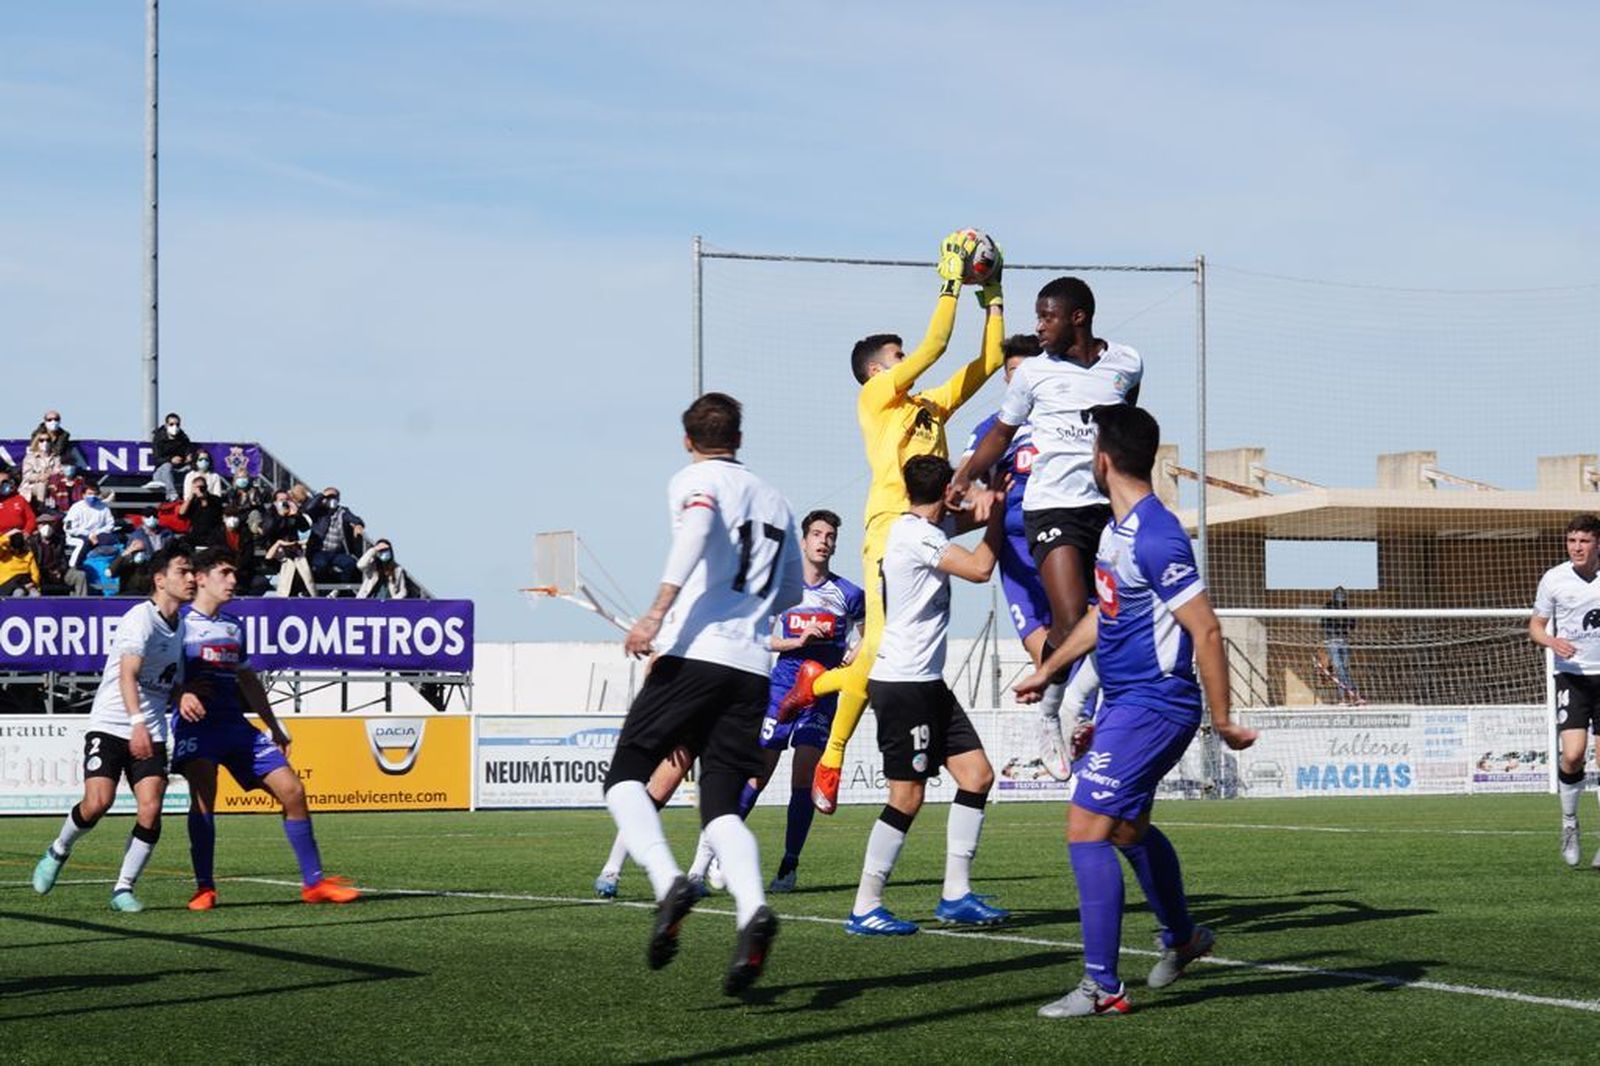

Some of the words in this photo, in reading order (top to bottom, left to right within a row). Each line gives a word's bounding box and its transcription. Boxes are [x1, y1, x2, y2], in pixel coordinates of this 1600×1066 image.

[731, 519, 786, 600] 17
[1010, 603, 1026, 630] 3
[238, 615, 466, 656] ILOMETROS
[376, 727, 416, 737] DACIA
[909, 724, 930, 750] 19
[1328, 732, 1412, 756] talleres
[89, 737, 101, 755] 2
[176, 737, 198, 757] 26
[484, 755, 610, 784] NEUMÁTICOS
[1296, 762, 1413, 790] MACIAS
[225, 789, 448, 808] www.jmanuelvicente.com
